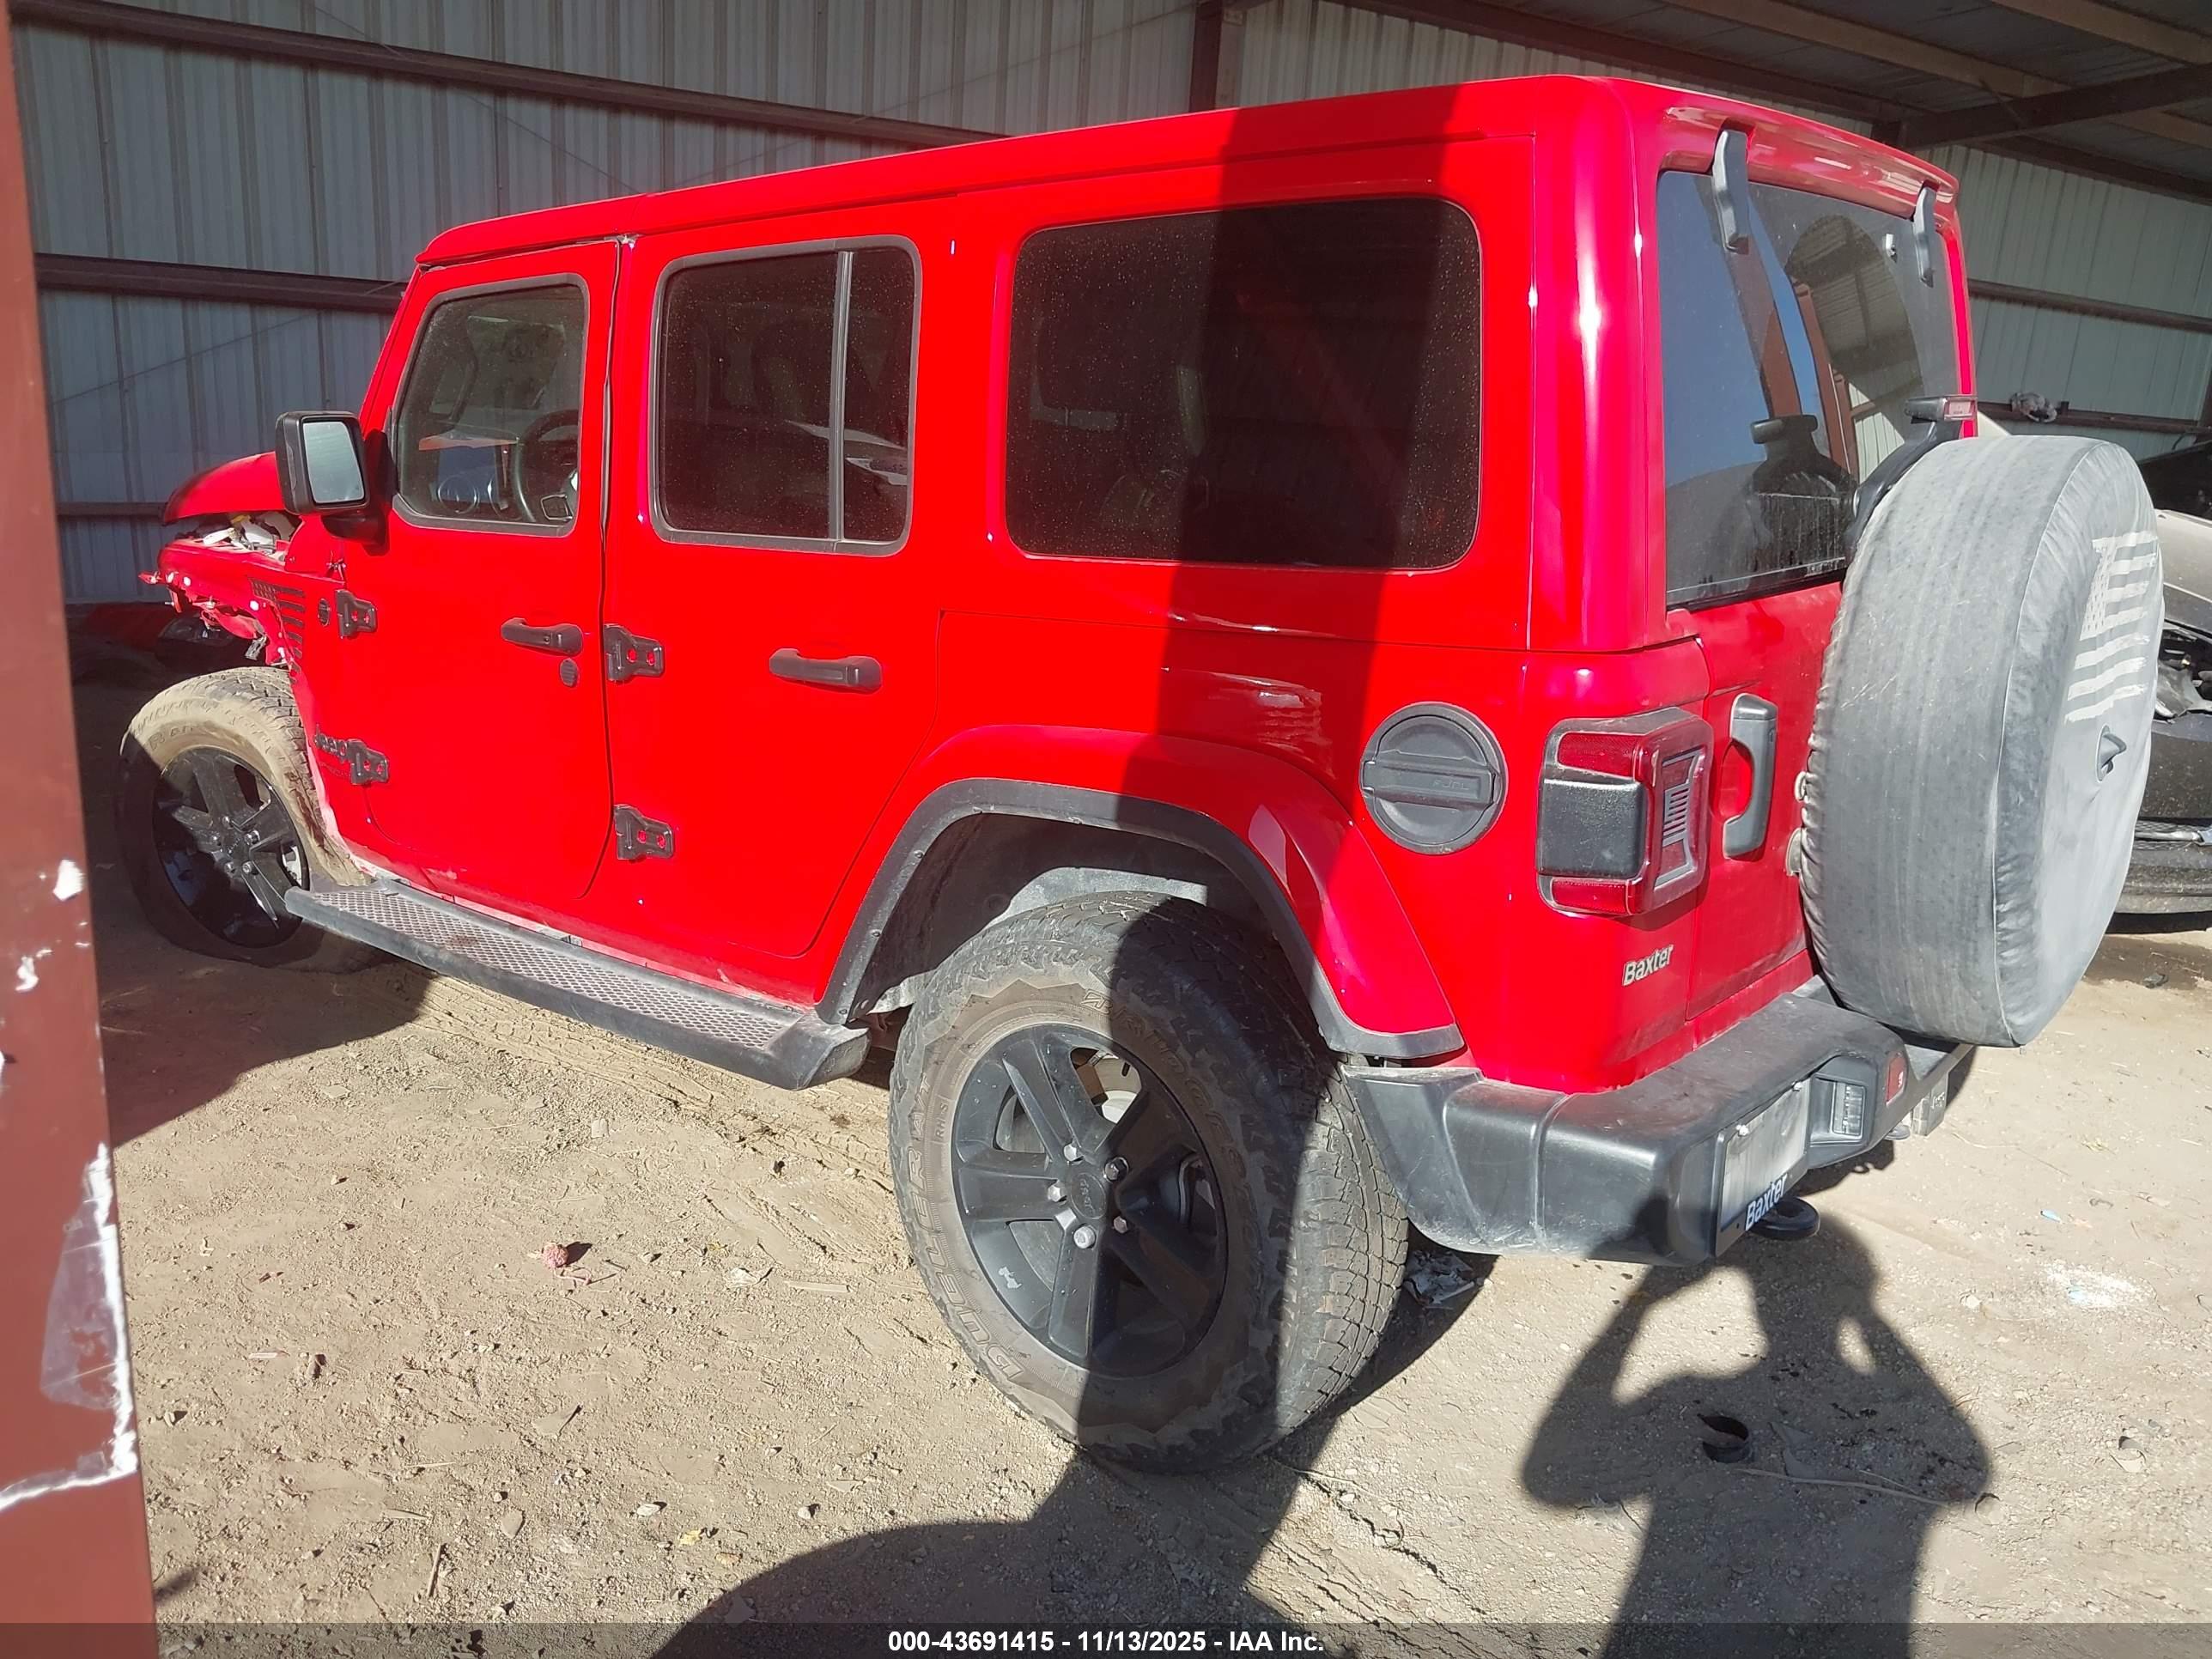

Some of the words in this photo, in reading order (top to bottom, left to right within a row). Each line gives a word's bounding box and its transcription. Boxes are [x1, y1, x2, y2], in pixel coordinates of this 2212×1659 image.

[1621, 944, 1674, 987] Baxter
[1744, 1173, 1788, 1231] Baxter
[907, 1146, 1024, 1381] DUELER
